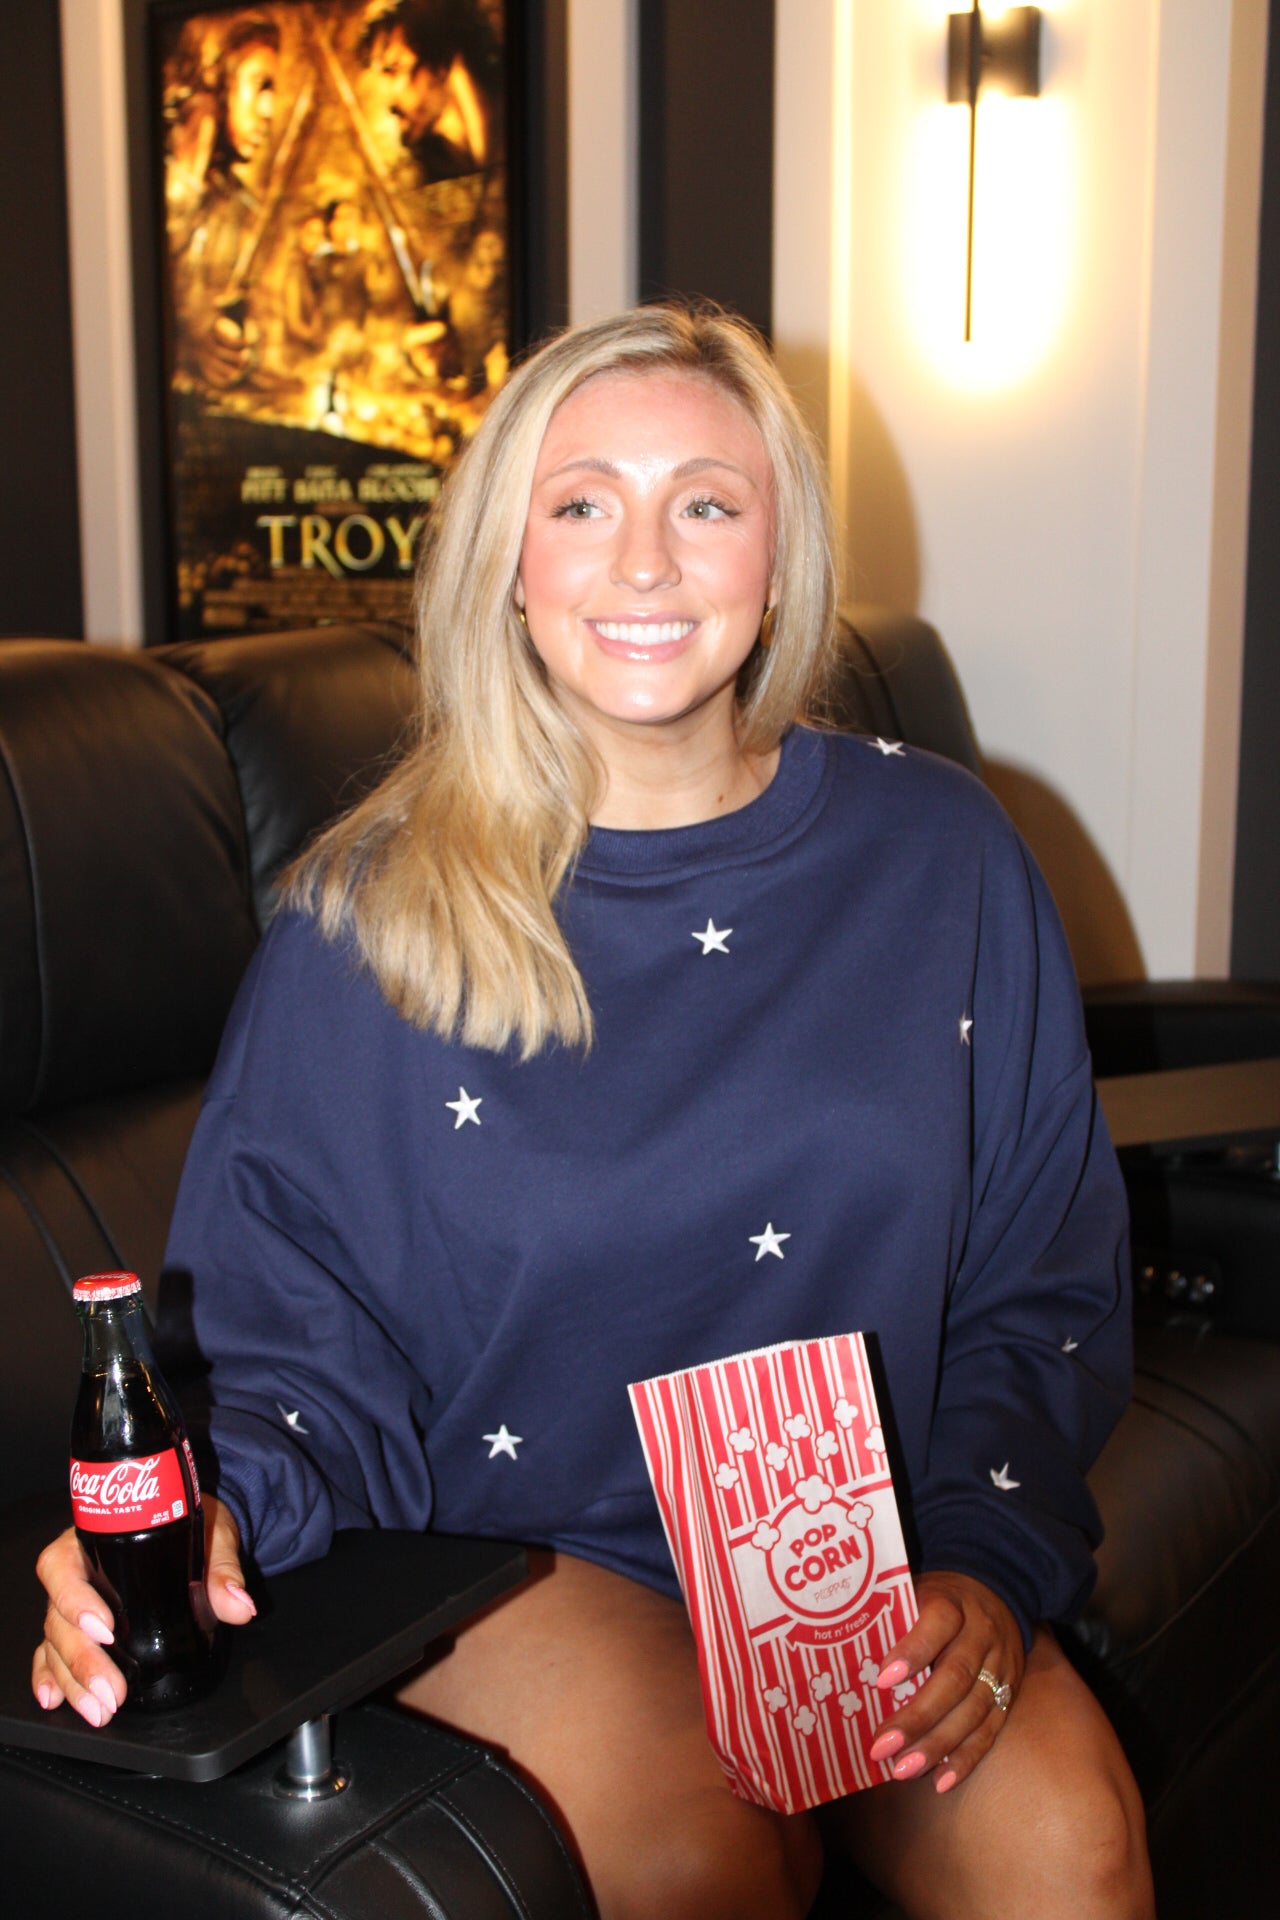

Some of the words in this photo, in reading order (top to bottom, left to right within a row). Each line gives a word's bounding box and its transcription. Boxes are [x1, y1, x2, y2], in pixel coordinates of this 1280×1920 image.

[256, 513, 425, 579] TROY
[70, 1456, 160, 1505] Coca-Cola
[79, 1505, 112, 1515] ORIGINAL
[113, 1504, 142, 1514] TASTE
[789, 1524, 837, 1558] POP
[784, 1535, 862, 1591] CORN
[814, 1629, 832, 1640] hot
[834, 1626, 844, 1637] n'
[845, 1611, 870, 1633] fresh
